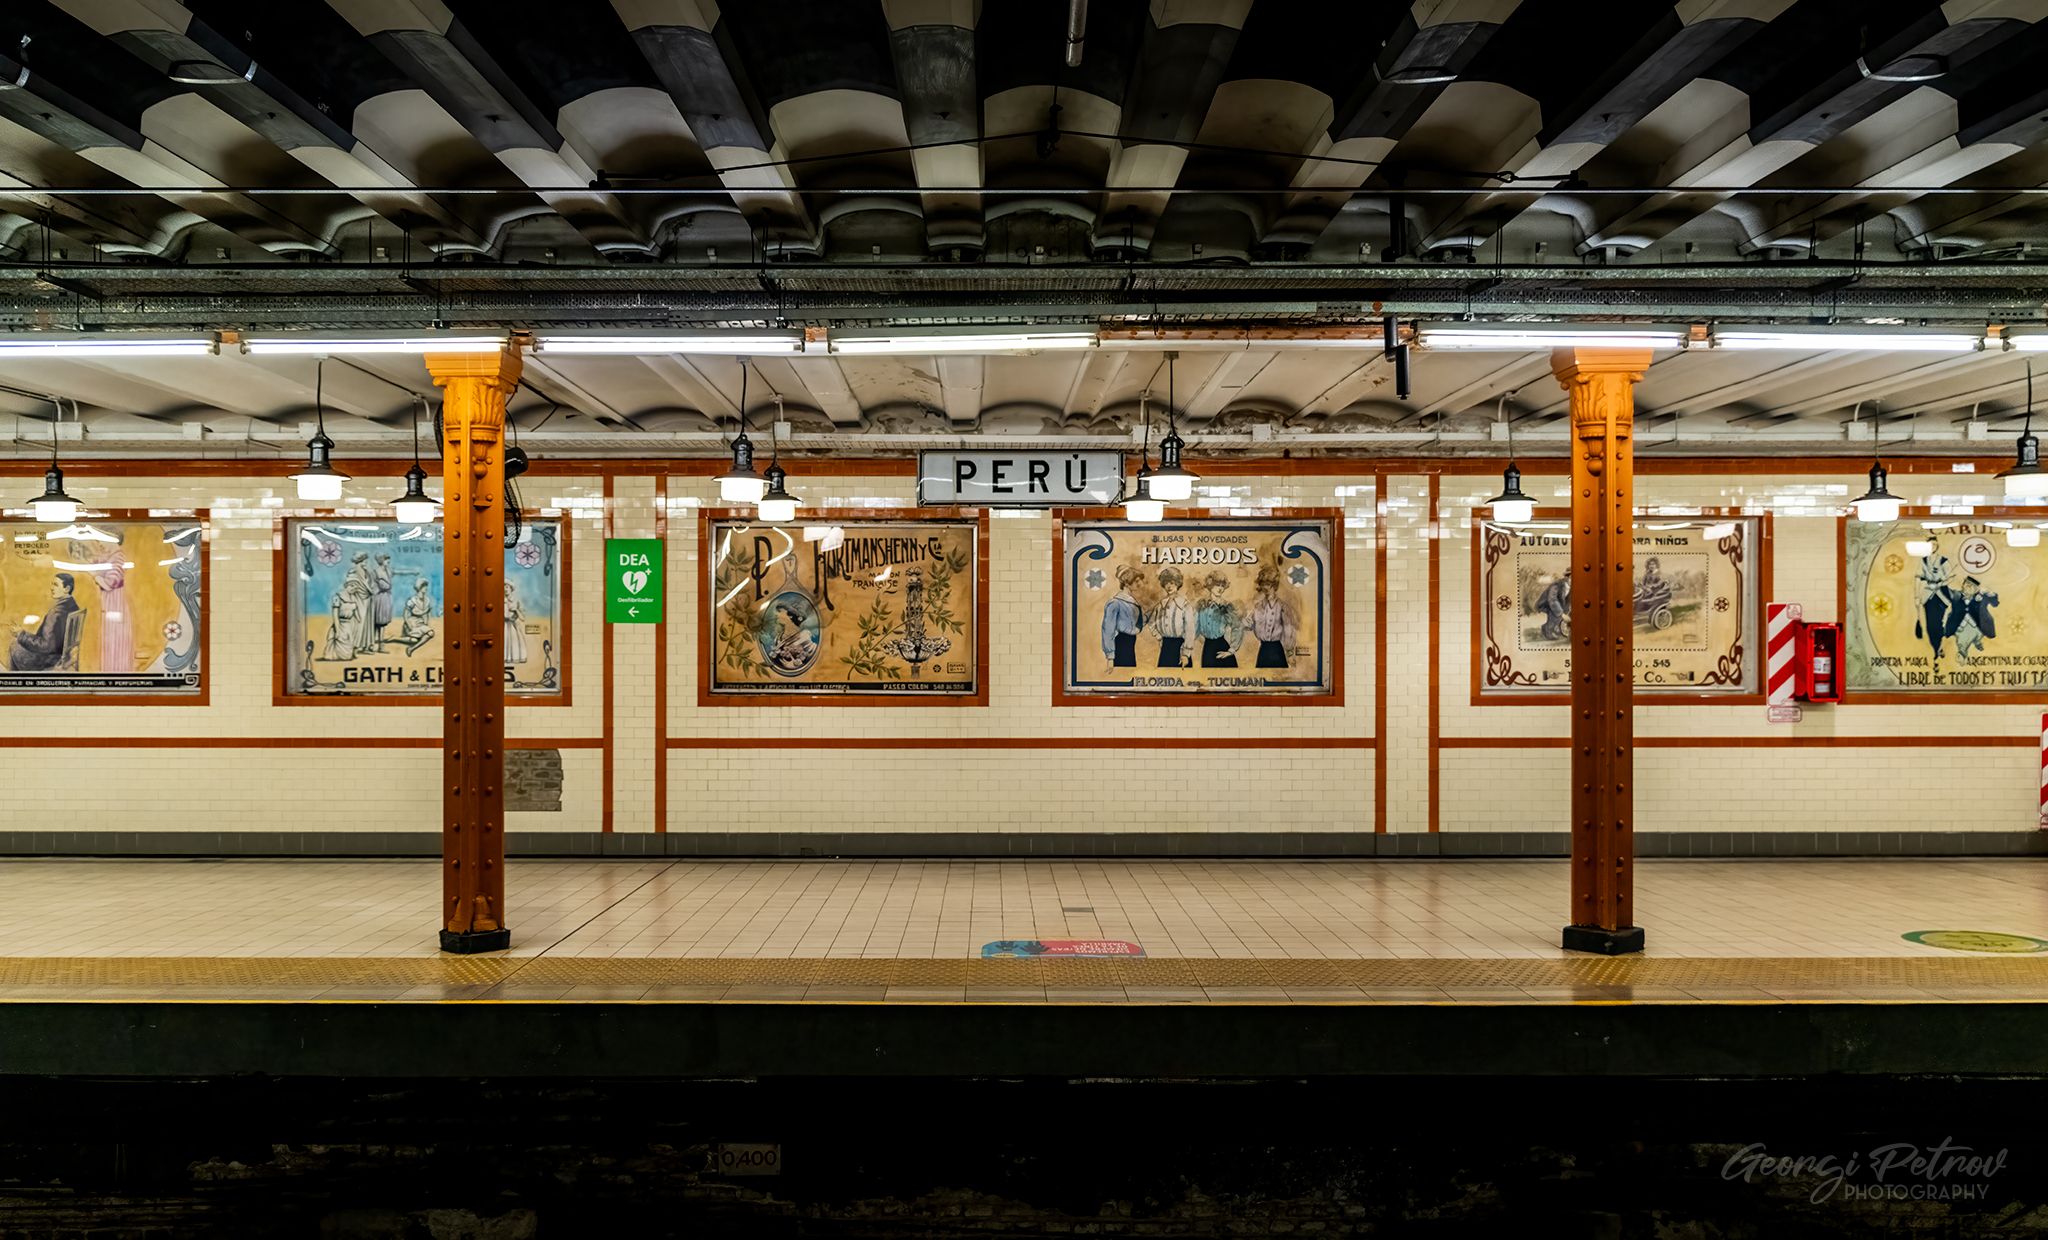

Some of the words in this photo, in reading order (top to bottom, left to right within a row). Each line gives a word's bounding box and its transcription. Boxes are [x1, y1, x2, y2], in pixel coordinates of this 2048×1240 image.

[955, 453, 1087, 494] PERÚ
[1151, 535, 1184, 543] BLUSAS
[1197, 535, 1248, 544] NOVEDADES
[1655, 536, 1689, 545] NIÑOS
[619, 553, 650, 566] DEA
[1142, 547, 1258, 565] HARRODS
[1652, 658, 1671, 668] 545
[343, 666, 403, 683] GATH
[410, 669, 419, 681] &
[1644, 670, 1666, 683] Co.
[1898, 670, 1931, 686] LIBRE
[1948, 670, 1980, 686] TODOS
[1134, 677, 1184, 688] FLORIDA
[721, 1150, 777, 1168] 0,400
